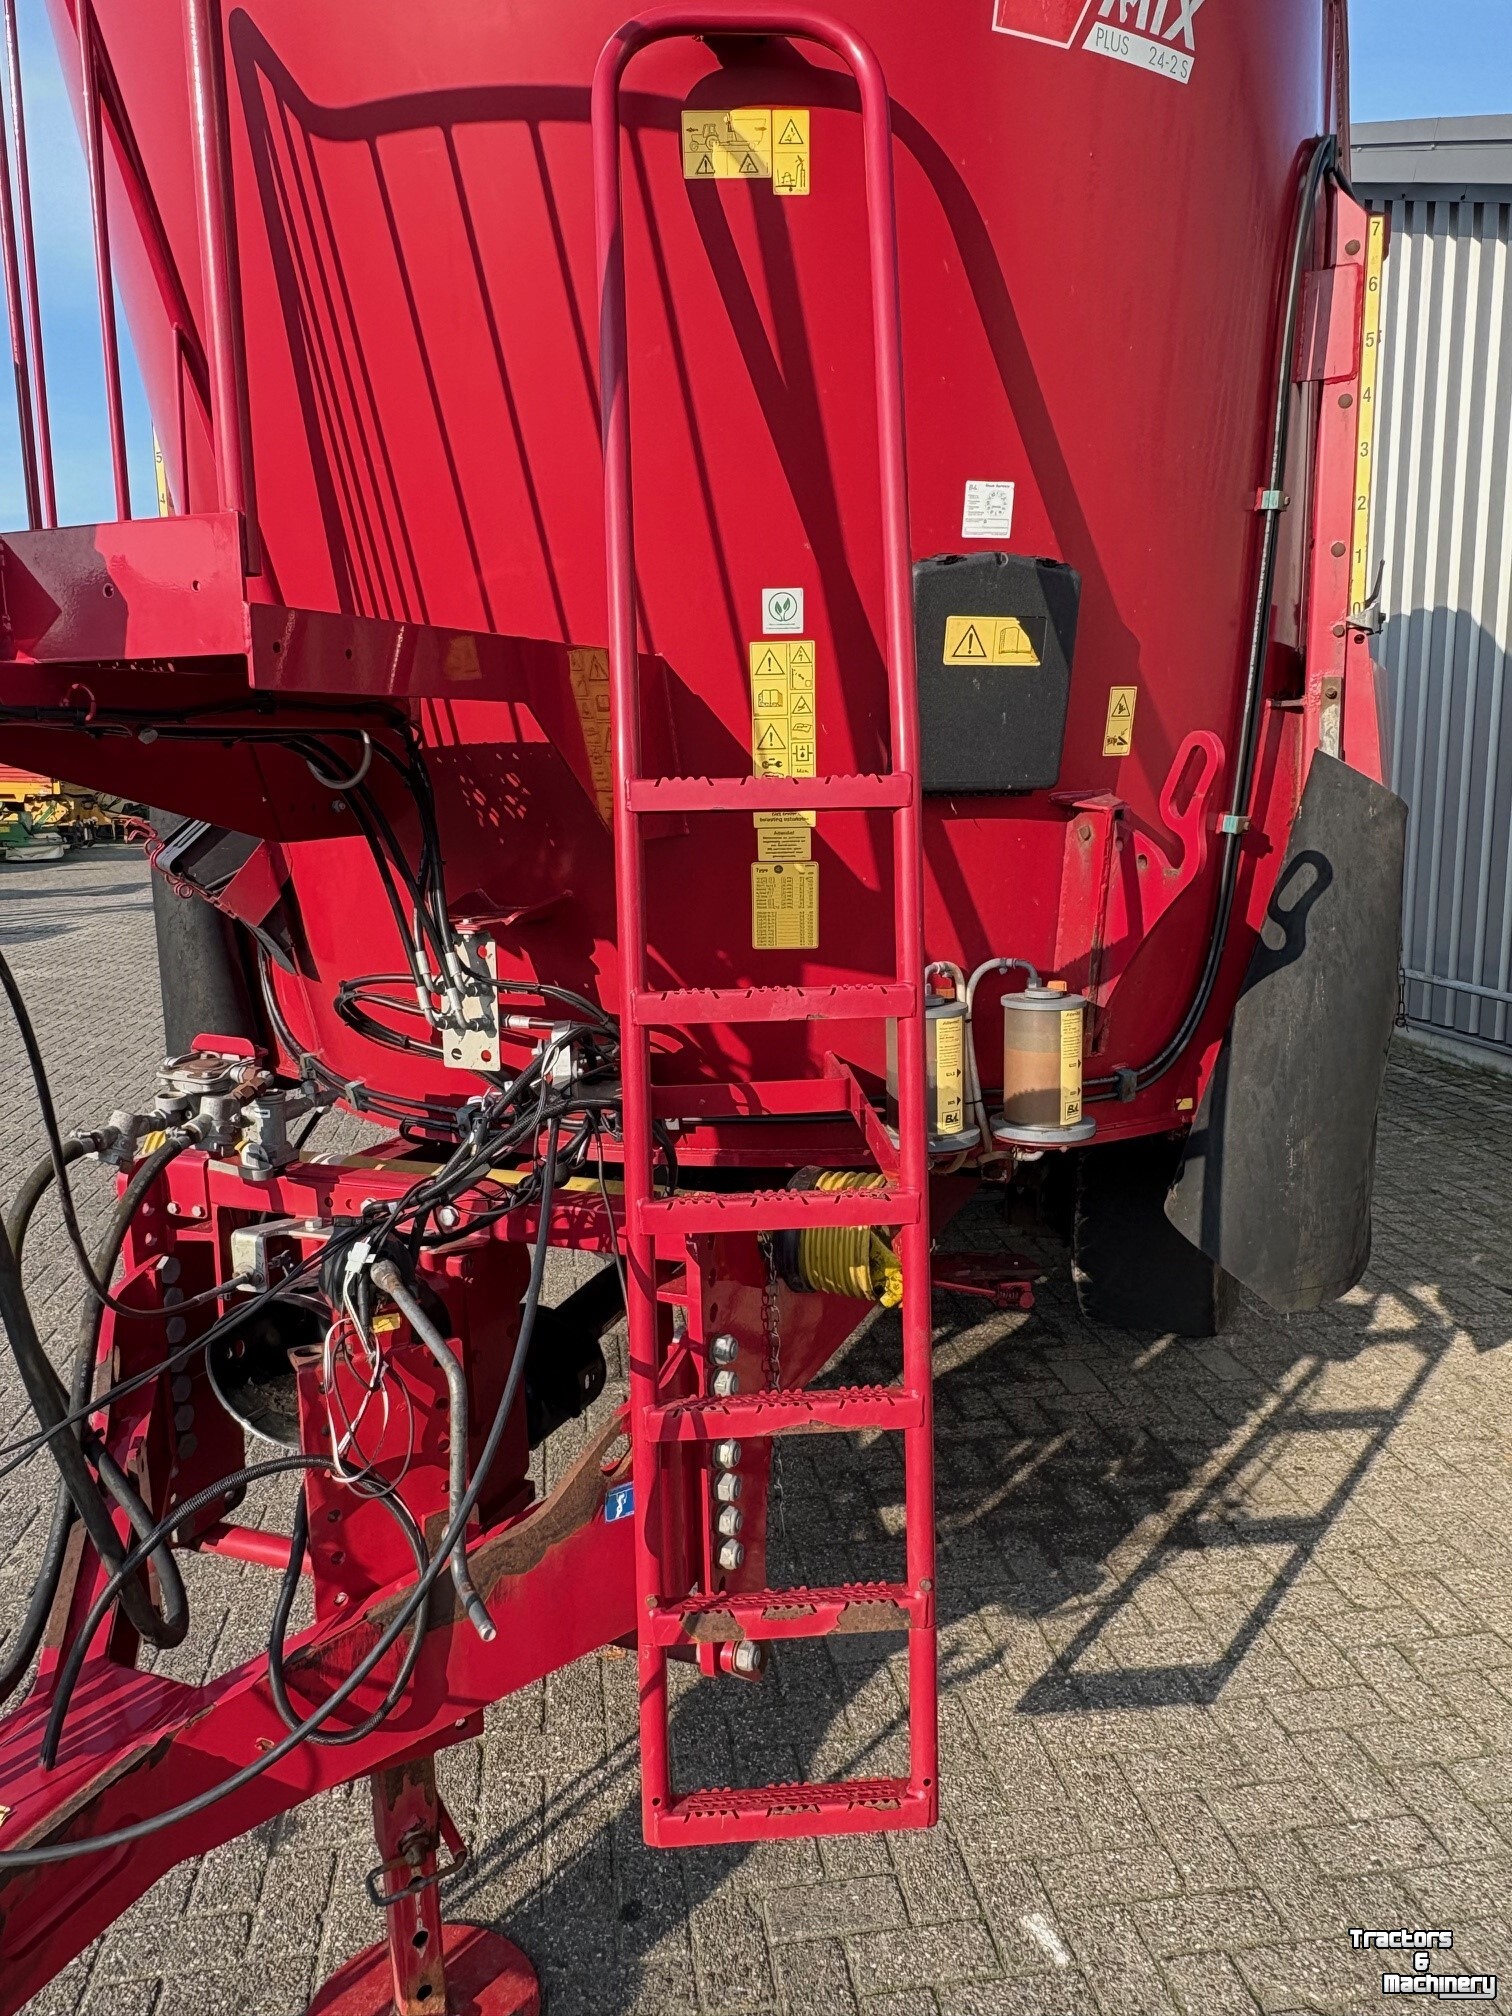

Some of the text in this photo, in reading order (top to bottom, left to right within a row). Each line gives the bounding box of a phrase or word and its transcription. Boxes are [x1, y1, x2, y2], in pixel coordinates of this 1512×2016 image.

[1096, 27, 1130, 55] PLUS
[1371, 221, 1381, 236] 7
[1368, 276, 1378, 292] 6
[1365, 331, 1375, 348] 5
[1362, 387, 1371, 402] 4
[1360, 442, 1369, 457] 3
[156, 452, 162, 463] 5
[1357, 496, 1366, 511] 2
[1355, 549, 1362, 564] 1
